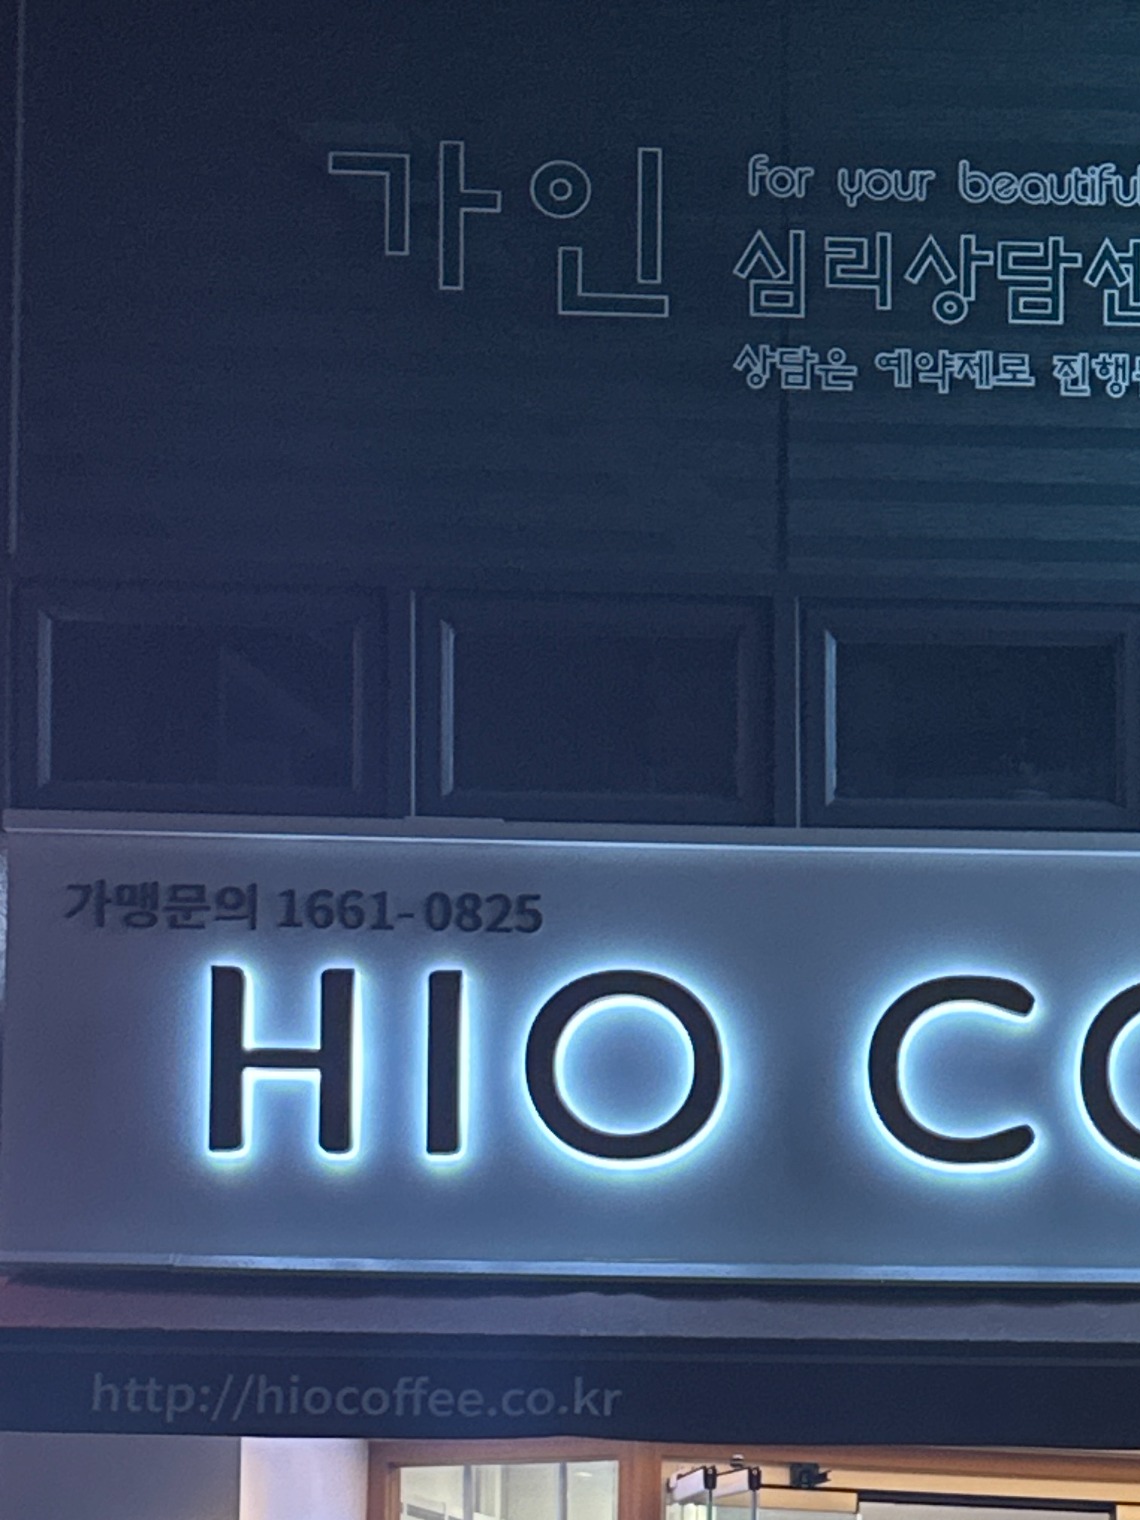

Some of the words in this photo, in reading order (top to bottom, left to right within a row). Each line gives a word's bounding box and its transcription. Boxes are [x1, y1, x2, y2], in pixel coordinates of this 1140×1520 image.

[747, 154, 814, 199] for
[837, 163, 936, 207] your
[328, 140, 669, 318] 가인
[732, 344, 858, 391] 상담은
[875, 347, 1035, 393] 예약제로
[64, 878, 258, 931] 가맹문의
[275, 887, 544, 934] 1661-0825
[208, 964, 726, 1162] HIO
[91, 1372, 623, 1423] http://hiocoffee.co.kr
